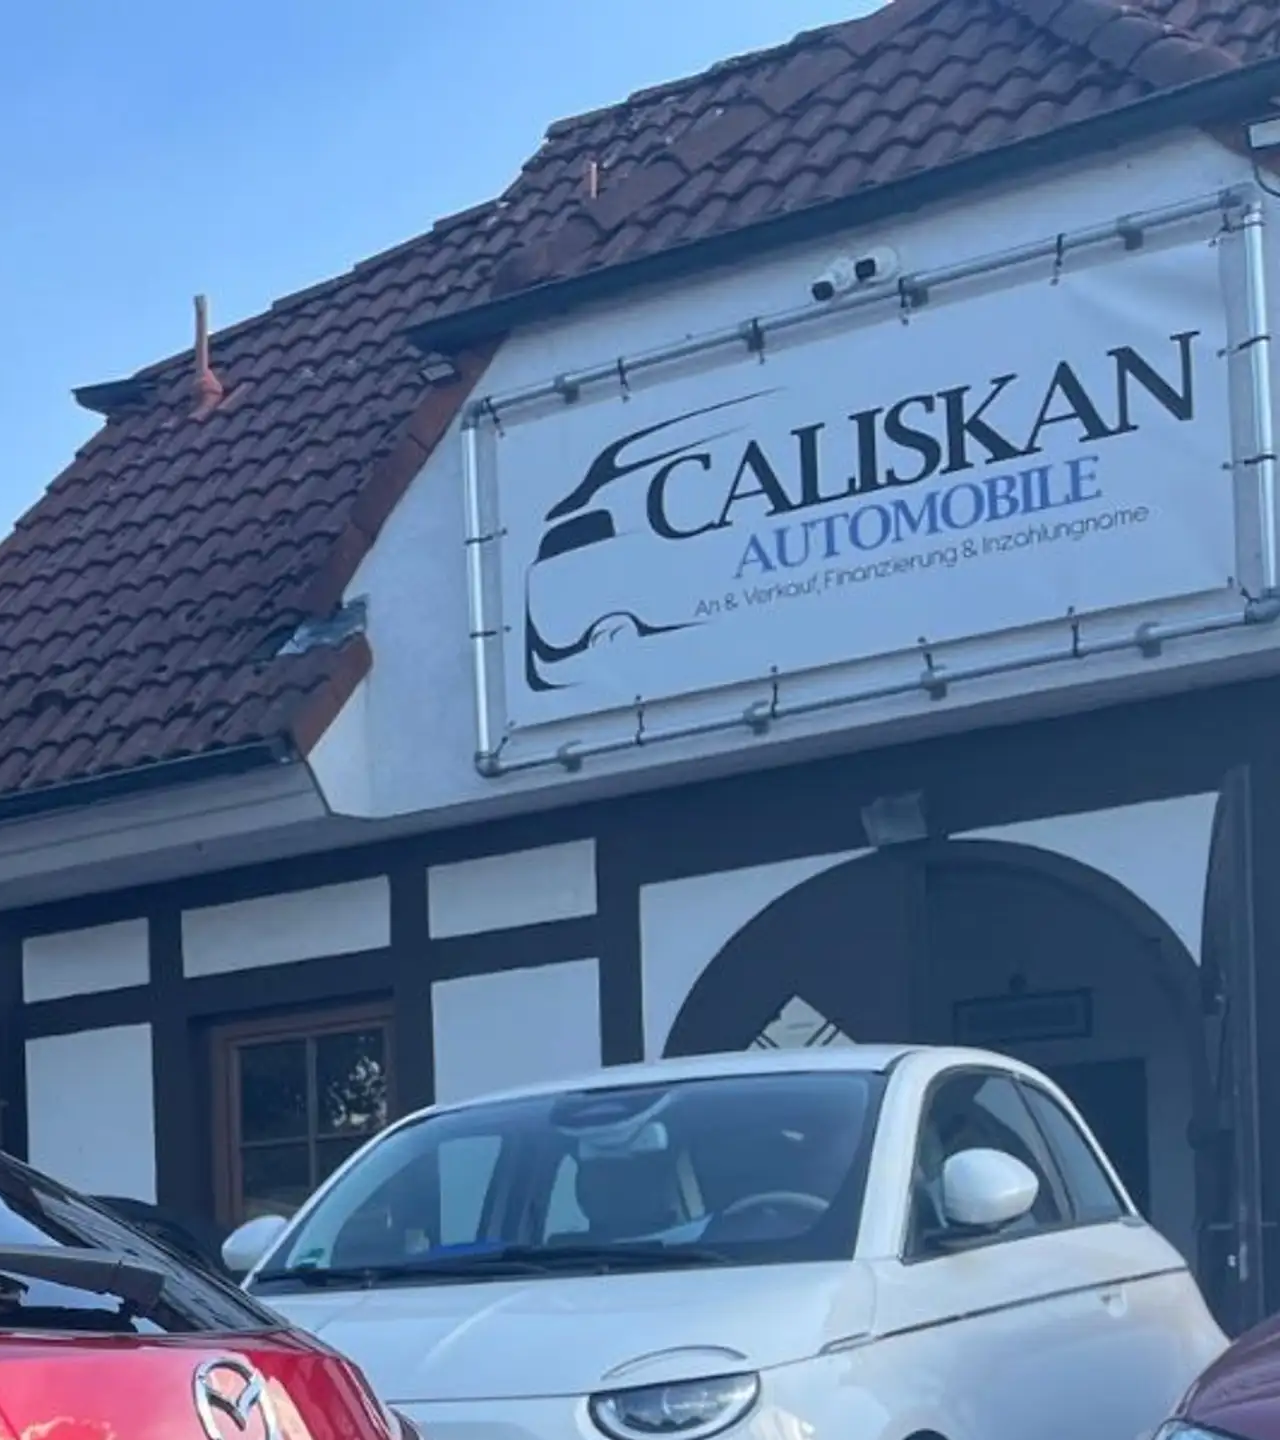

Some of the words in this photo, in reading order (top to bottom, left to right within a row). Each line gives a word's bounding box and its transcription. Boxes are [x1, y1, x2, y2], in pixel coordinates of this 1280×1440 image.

[647, 331, 1199, 540] CALISKAN
[733, 456, 1103, 579] AUTOMOBILE
[962, 538, 978, 559] &
